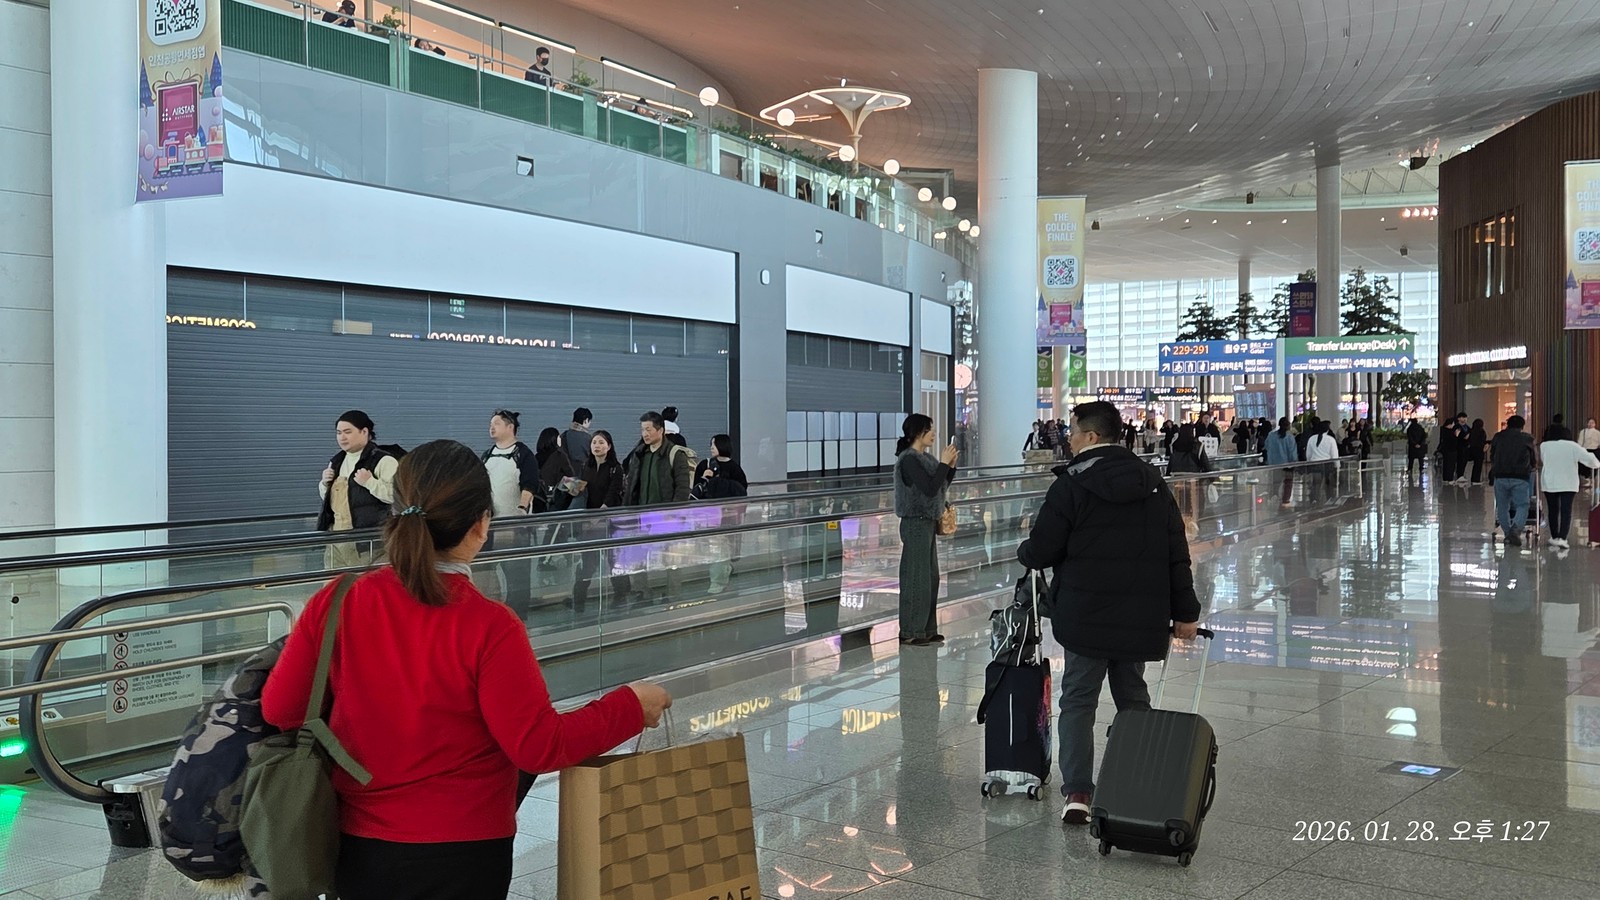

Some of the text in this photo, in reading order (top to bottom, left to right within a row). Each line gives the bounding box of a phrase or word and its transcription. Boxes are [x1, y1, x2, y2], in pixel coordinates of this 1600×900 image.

[172, 104, 195, 116] AIRSTAR
[1052, 212, 1069, 222] THE
[1045, 222, 1077, 232] GOLDEN
[1047, 232, 1076, 242] FINALE
[1172, 345, 1209, 355] 229-291
[1307, 341, 1339, 352] Transfer
